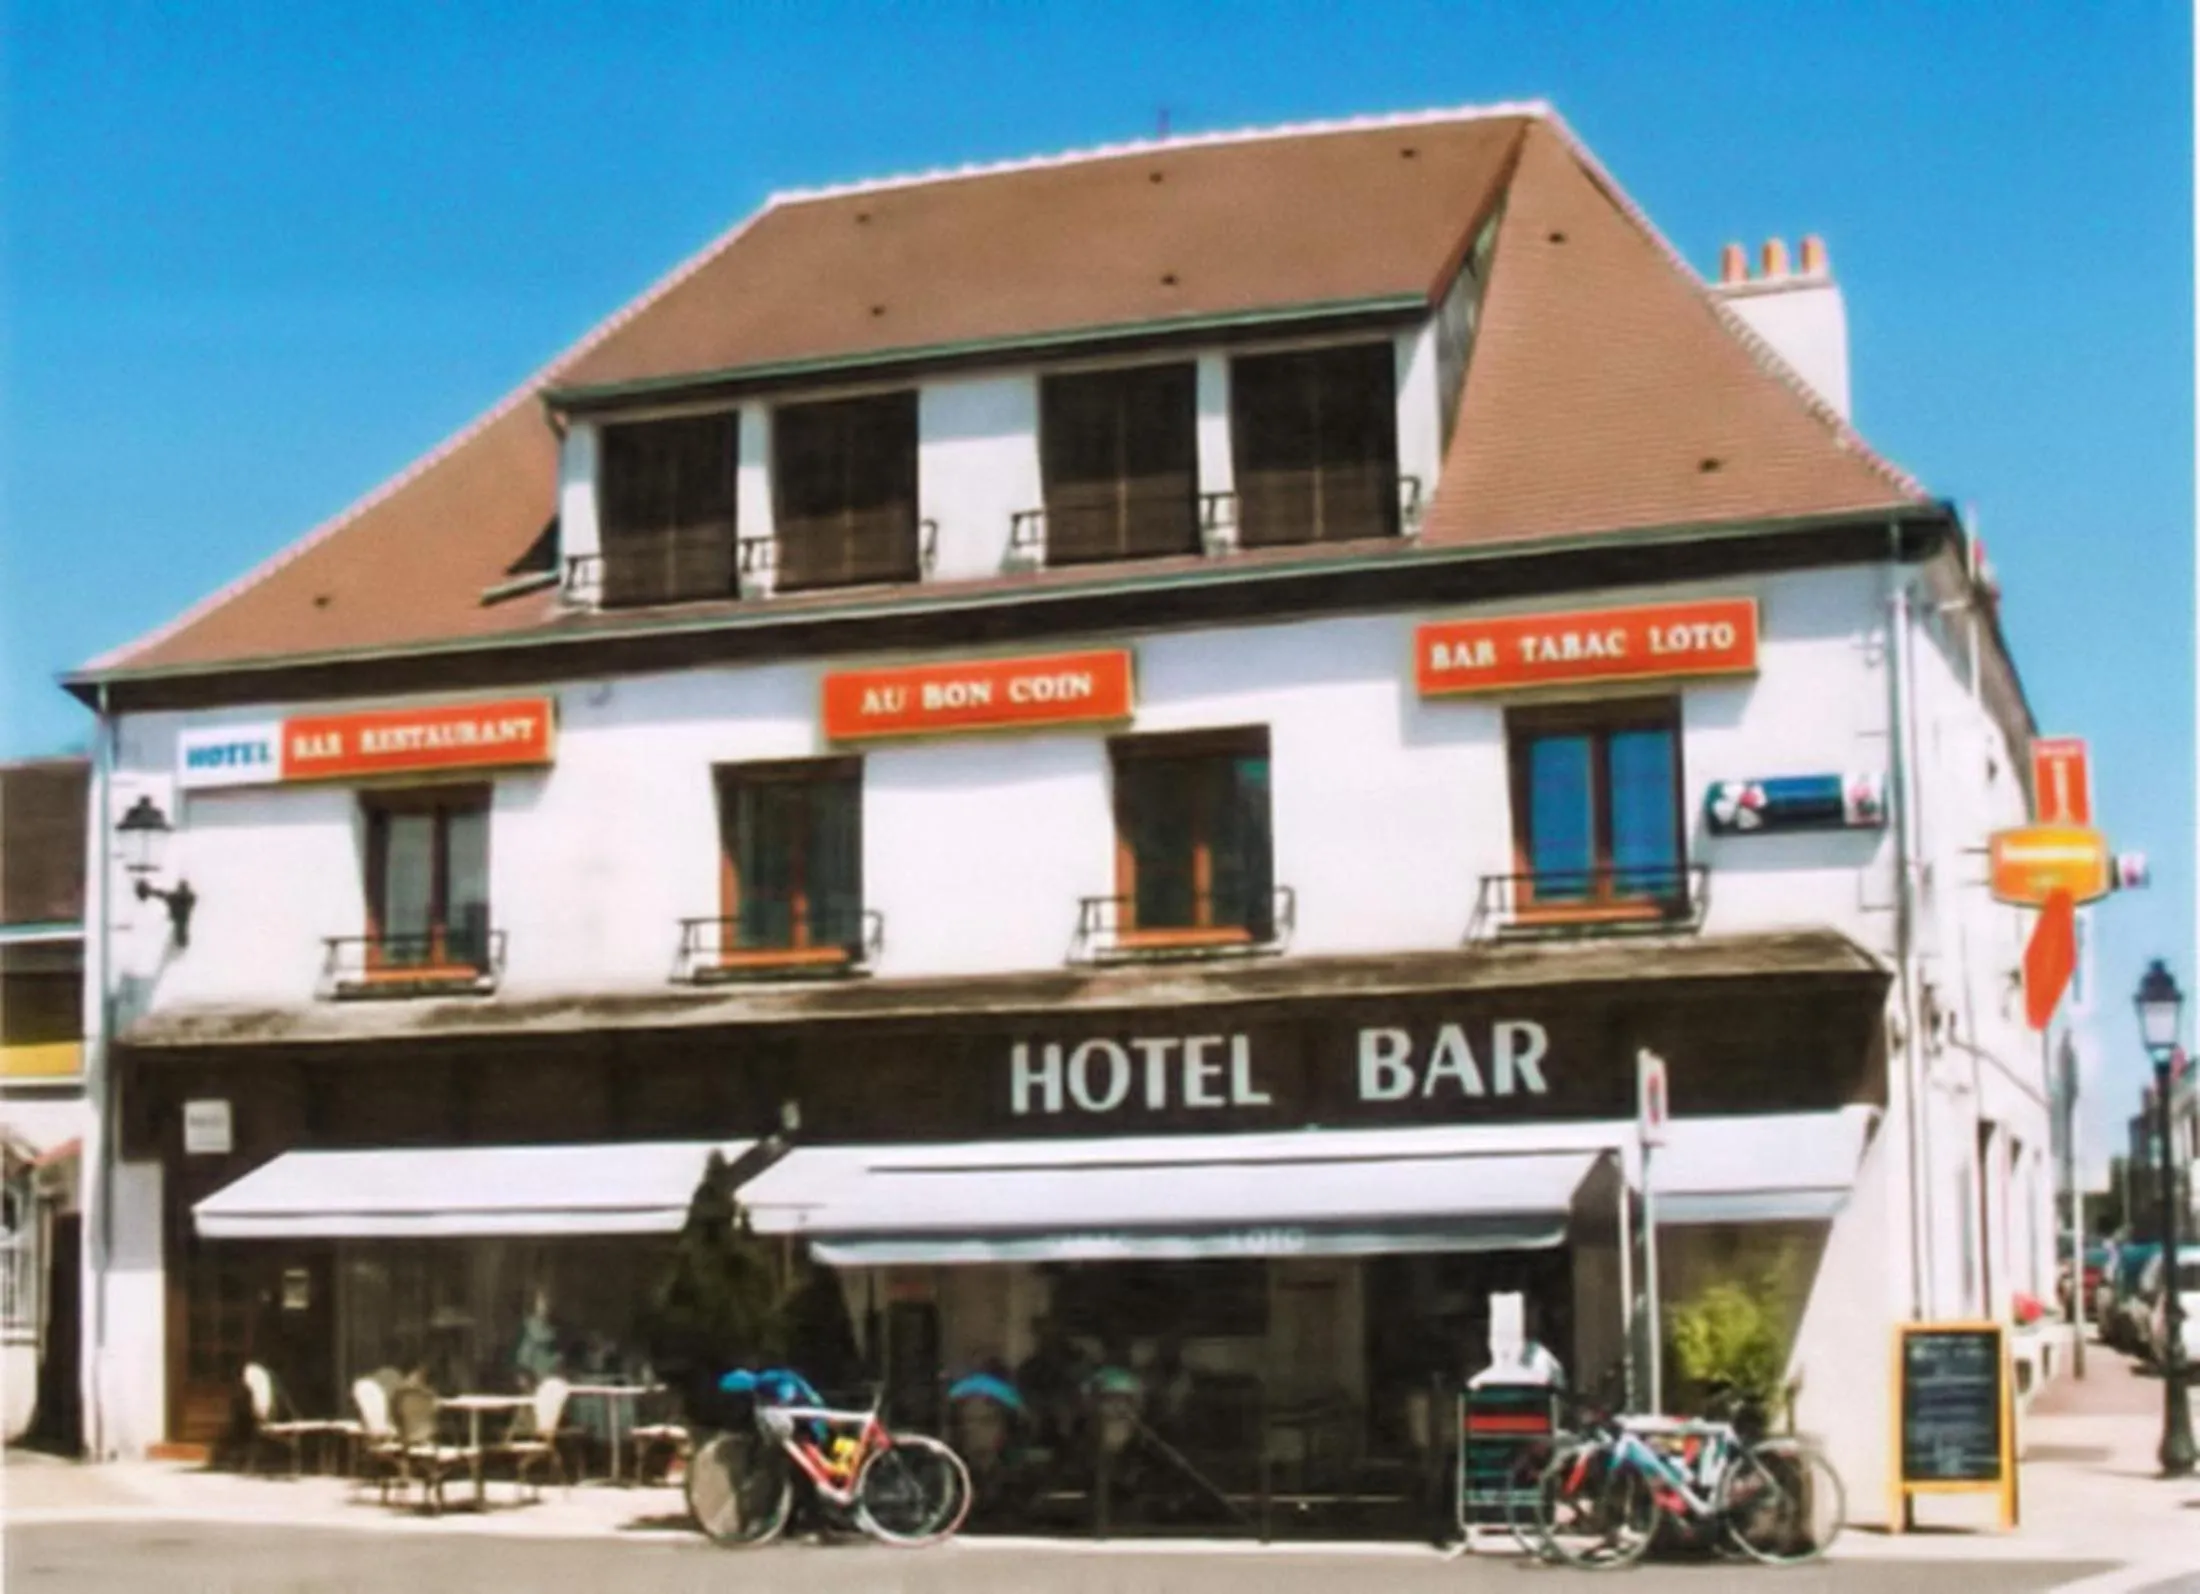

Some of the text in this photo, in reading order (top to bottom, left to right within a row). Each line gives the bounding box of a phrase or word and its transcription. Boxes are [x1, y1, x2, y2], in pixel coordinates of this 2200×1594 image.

[1431, 621, 1735, 671] BAR TABAC LOTO
[861, 672, 1092, 715] AU BON COIN
[185, 741, 271, 769] HOTEL
[293, 718, 537, 760] BAR RESTAURANT
[1011, 1020, 1549, 1114] HOTEL BAR
